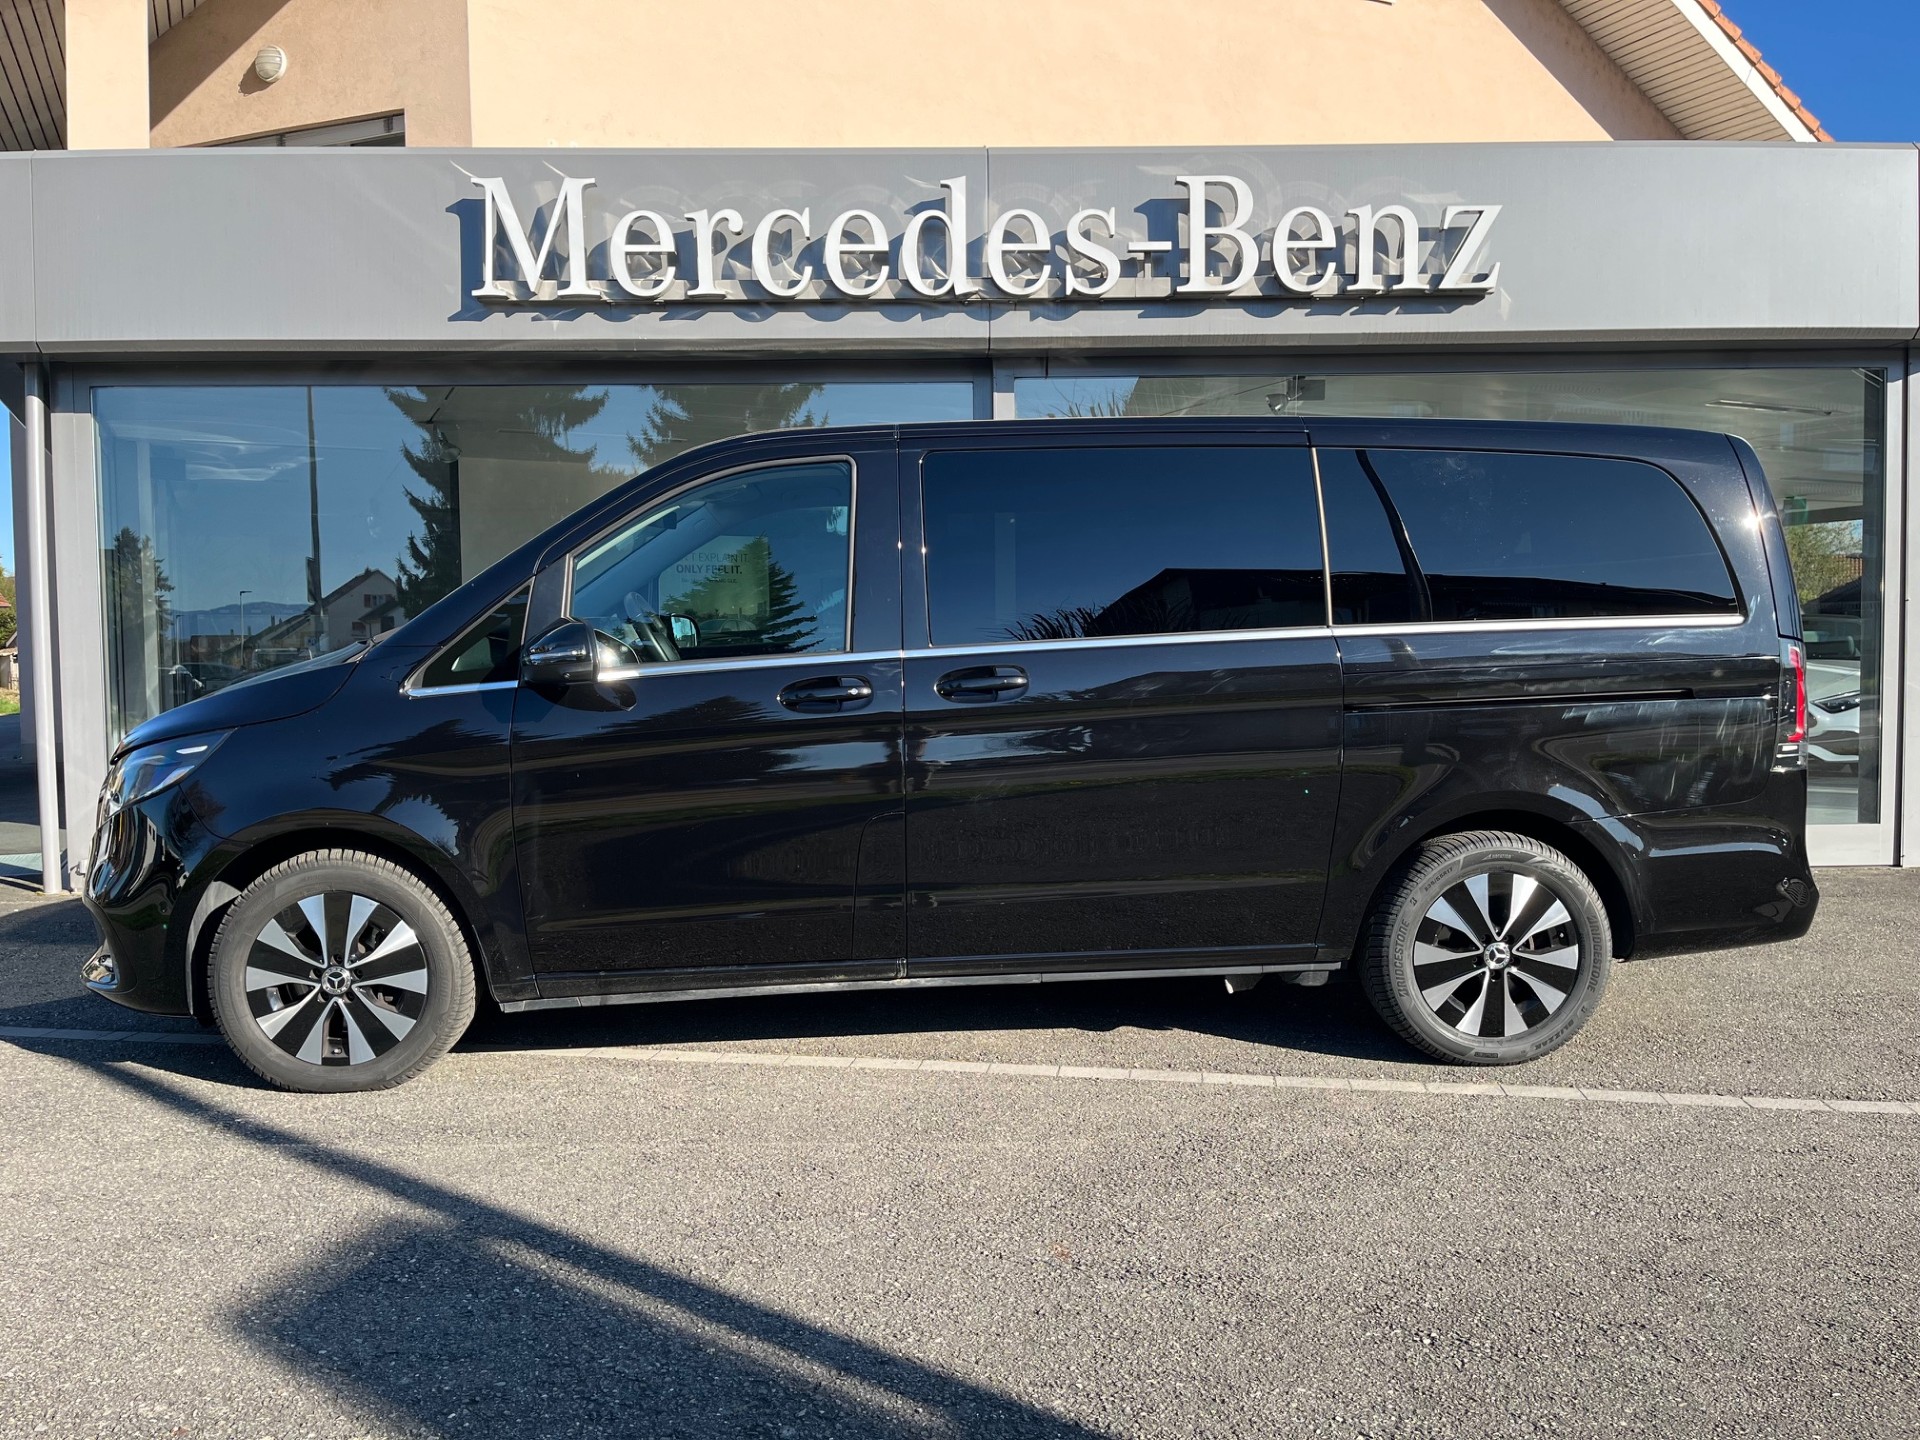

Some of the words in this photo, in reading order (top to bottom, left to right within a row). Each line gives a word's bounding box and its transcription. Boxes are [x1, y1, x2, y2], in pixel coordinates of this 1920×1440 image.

[470, 174, 1503, 298] Mercedes-Benz
[676, 564, 704, 574] ONLY
[705, 564, 729, 575] FEEL
[731, 565, 743, 575] IT.
[1393, 919, 1411, 998] BRIDGESTONE
[1586, 914, 1603, 993] BRIDGESTONE
